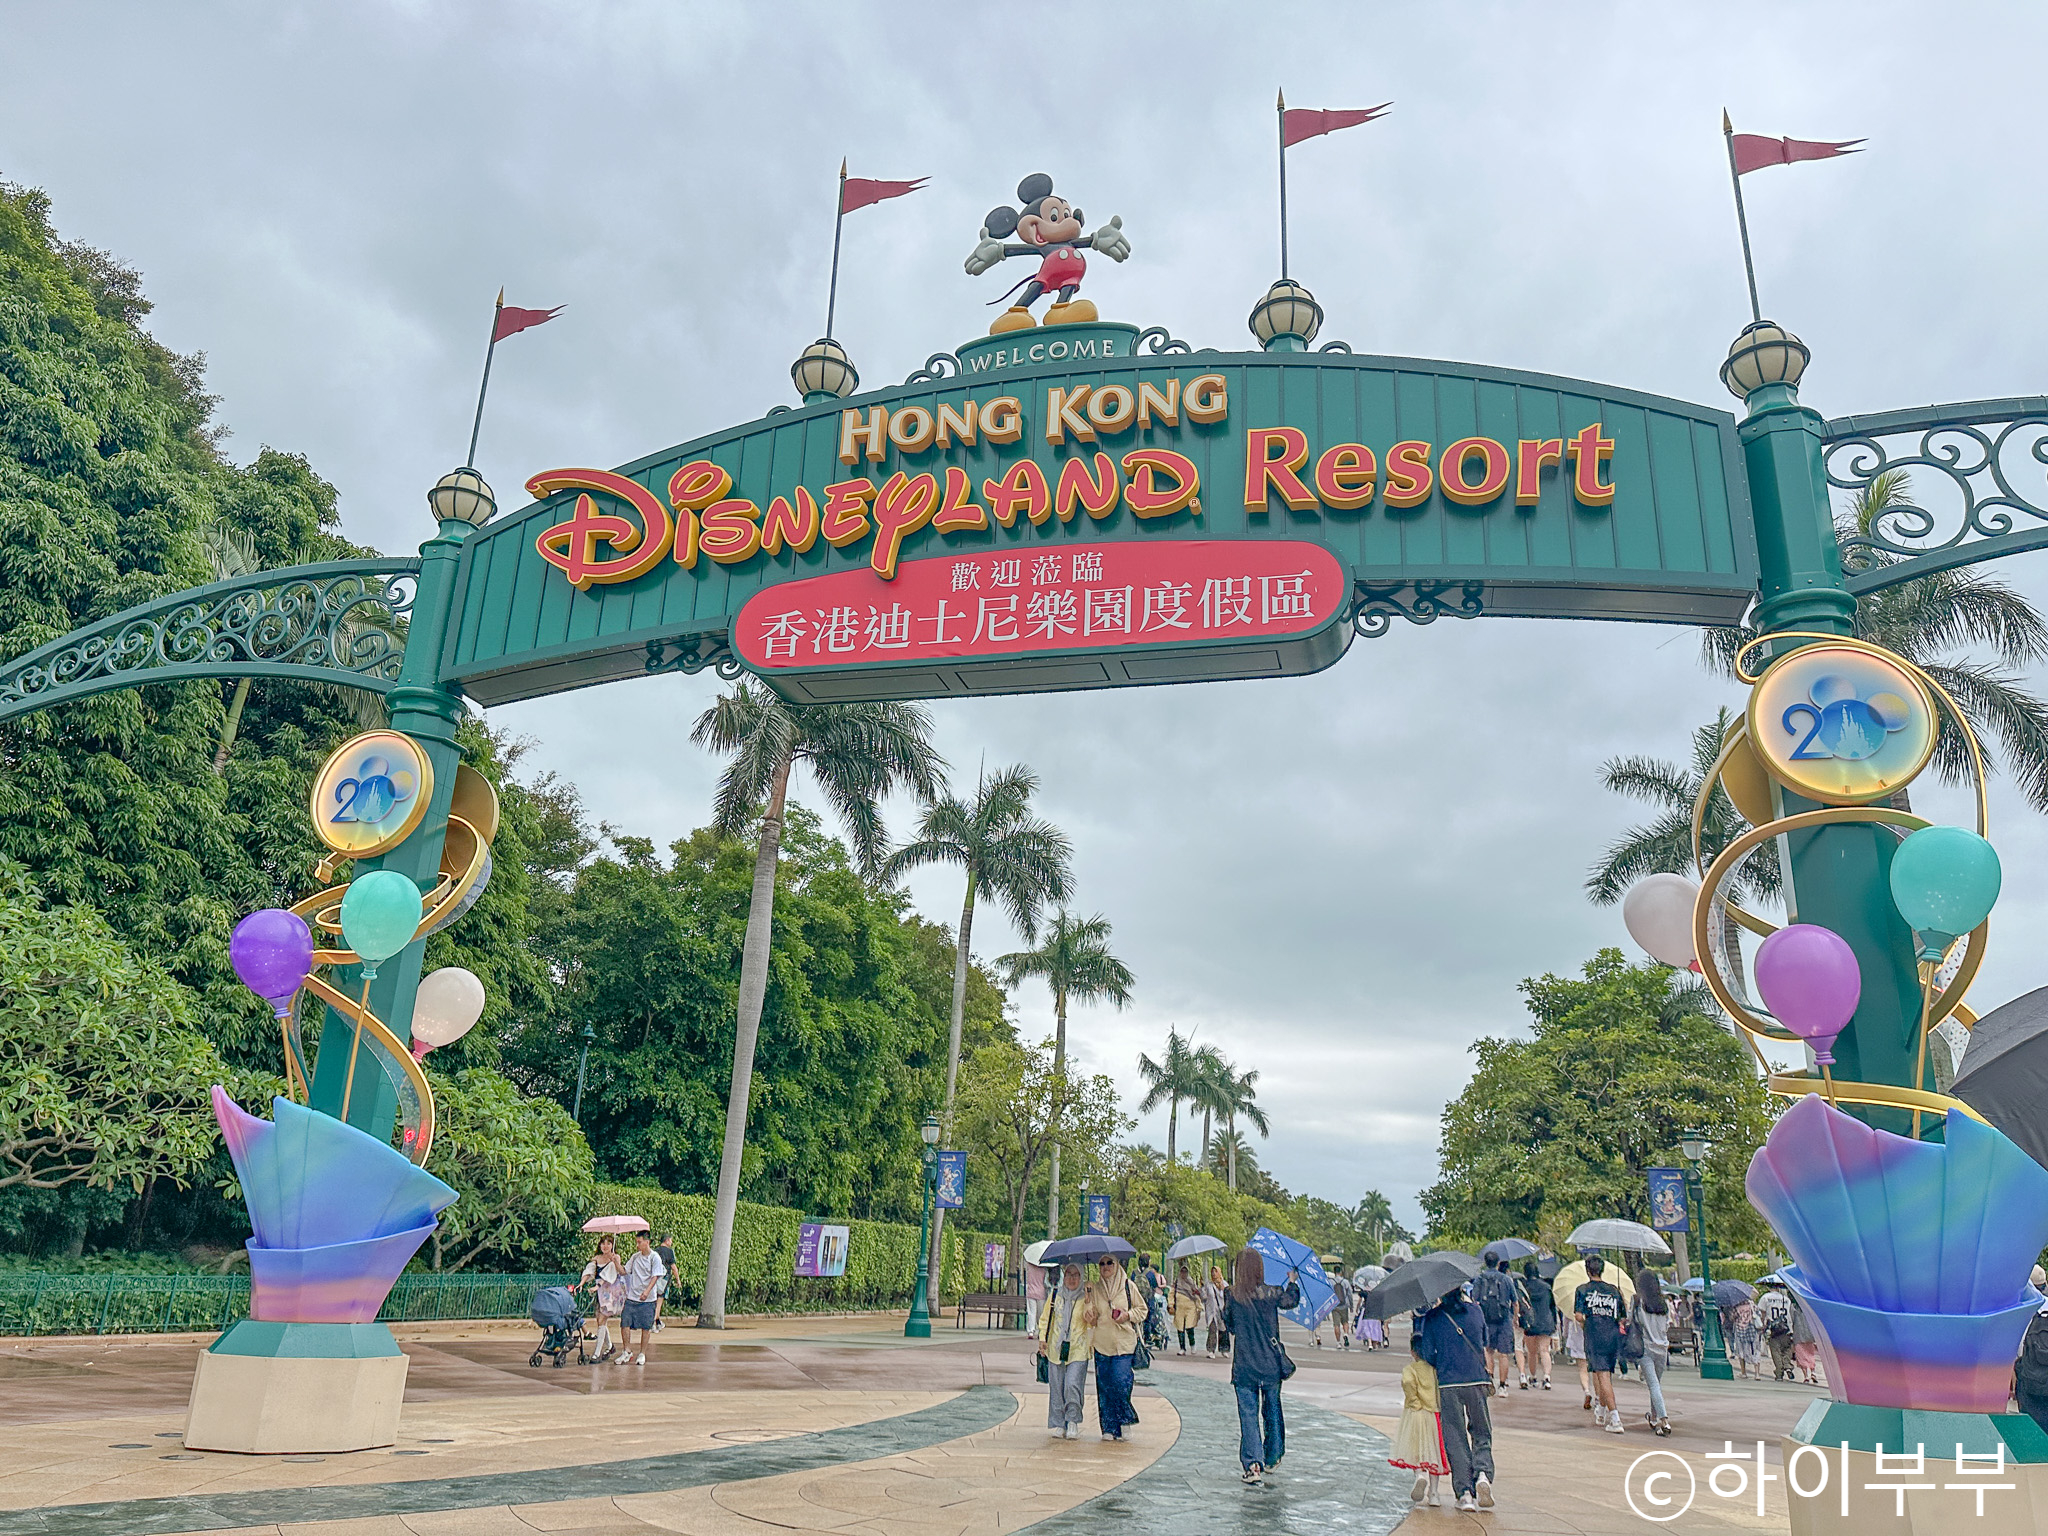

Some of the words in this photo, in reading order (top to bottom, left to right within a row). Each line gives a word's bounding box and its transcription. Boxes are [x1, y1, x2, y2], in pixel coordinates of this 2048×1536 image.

[970, 339, 1115, 373] WELCOME
[838, 396, 1023, 466] HONG
[1045, 373, 1228, 446] KONG
[1243, 421, 1617, 512] Resort
[758, 569, 1315, 659] 香港迪士尼樂園度假區
[949, 551, 1104, 593] 歡迎蒞臨
